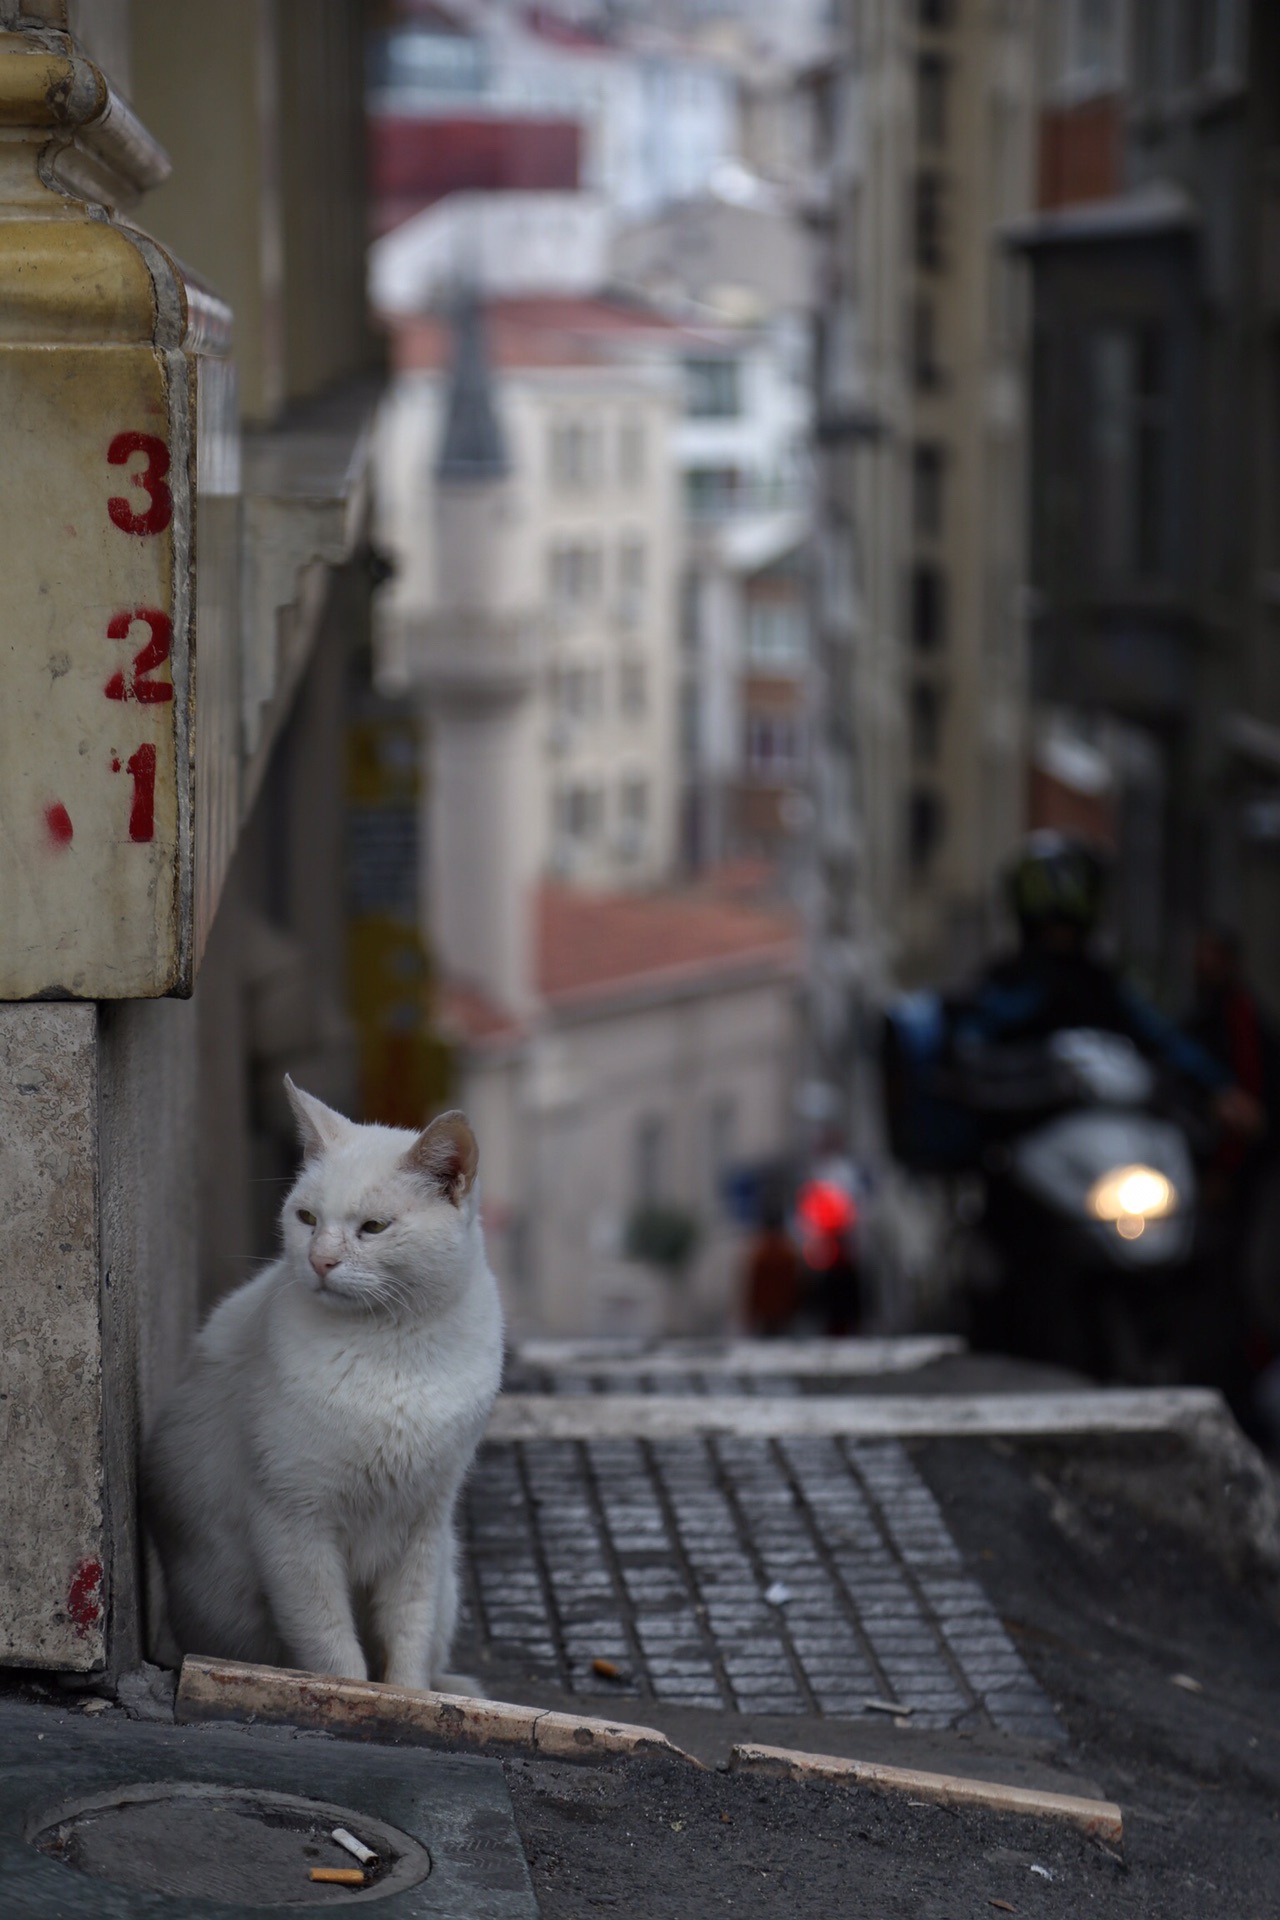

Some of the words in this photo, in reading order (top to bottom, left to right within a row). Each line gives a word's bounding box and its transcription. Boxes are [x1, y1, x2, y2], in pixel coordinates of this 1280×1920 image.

[107, 431, 174, 536] 3
[104, 607, 174, 704] 2
[126, 743, 157, 843] 1
